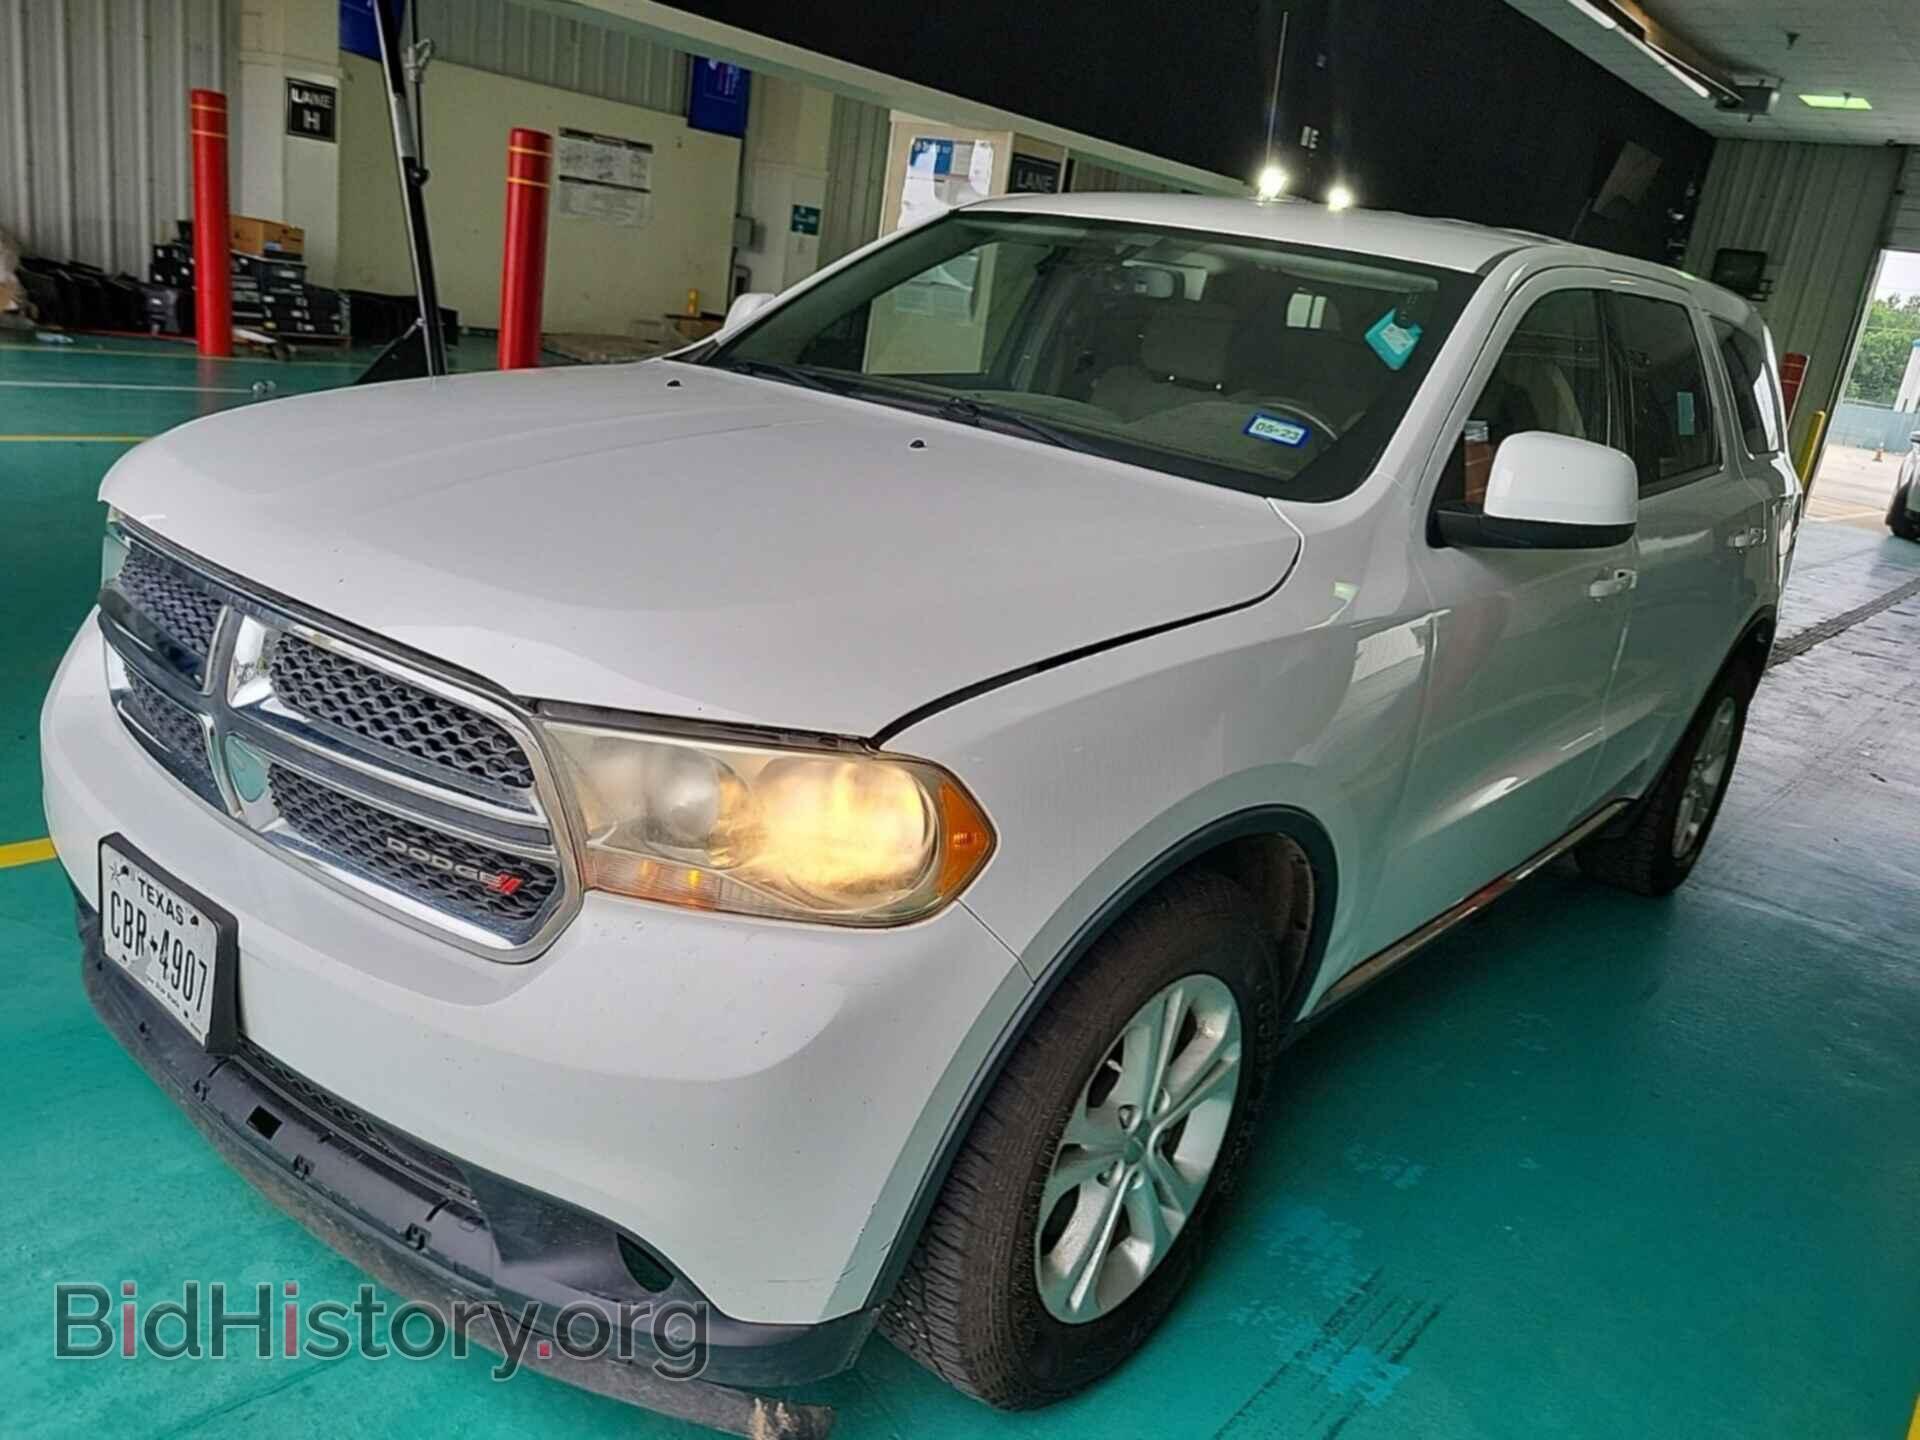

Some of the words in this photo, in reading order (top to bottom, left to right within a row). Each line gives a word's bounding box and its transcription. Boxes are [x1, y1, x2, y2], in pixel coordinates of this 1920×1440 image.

[291, 88, 333, 109] LANE
[303, 110, 320, 130] H
[1016, 168, 1054, 192] LANE
[387, 837, 502, 889] DODGE
[138, 878, 184, 926] TEXAS
